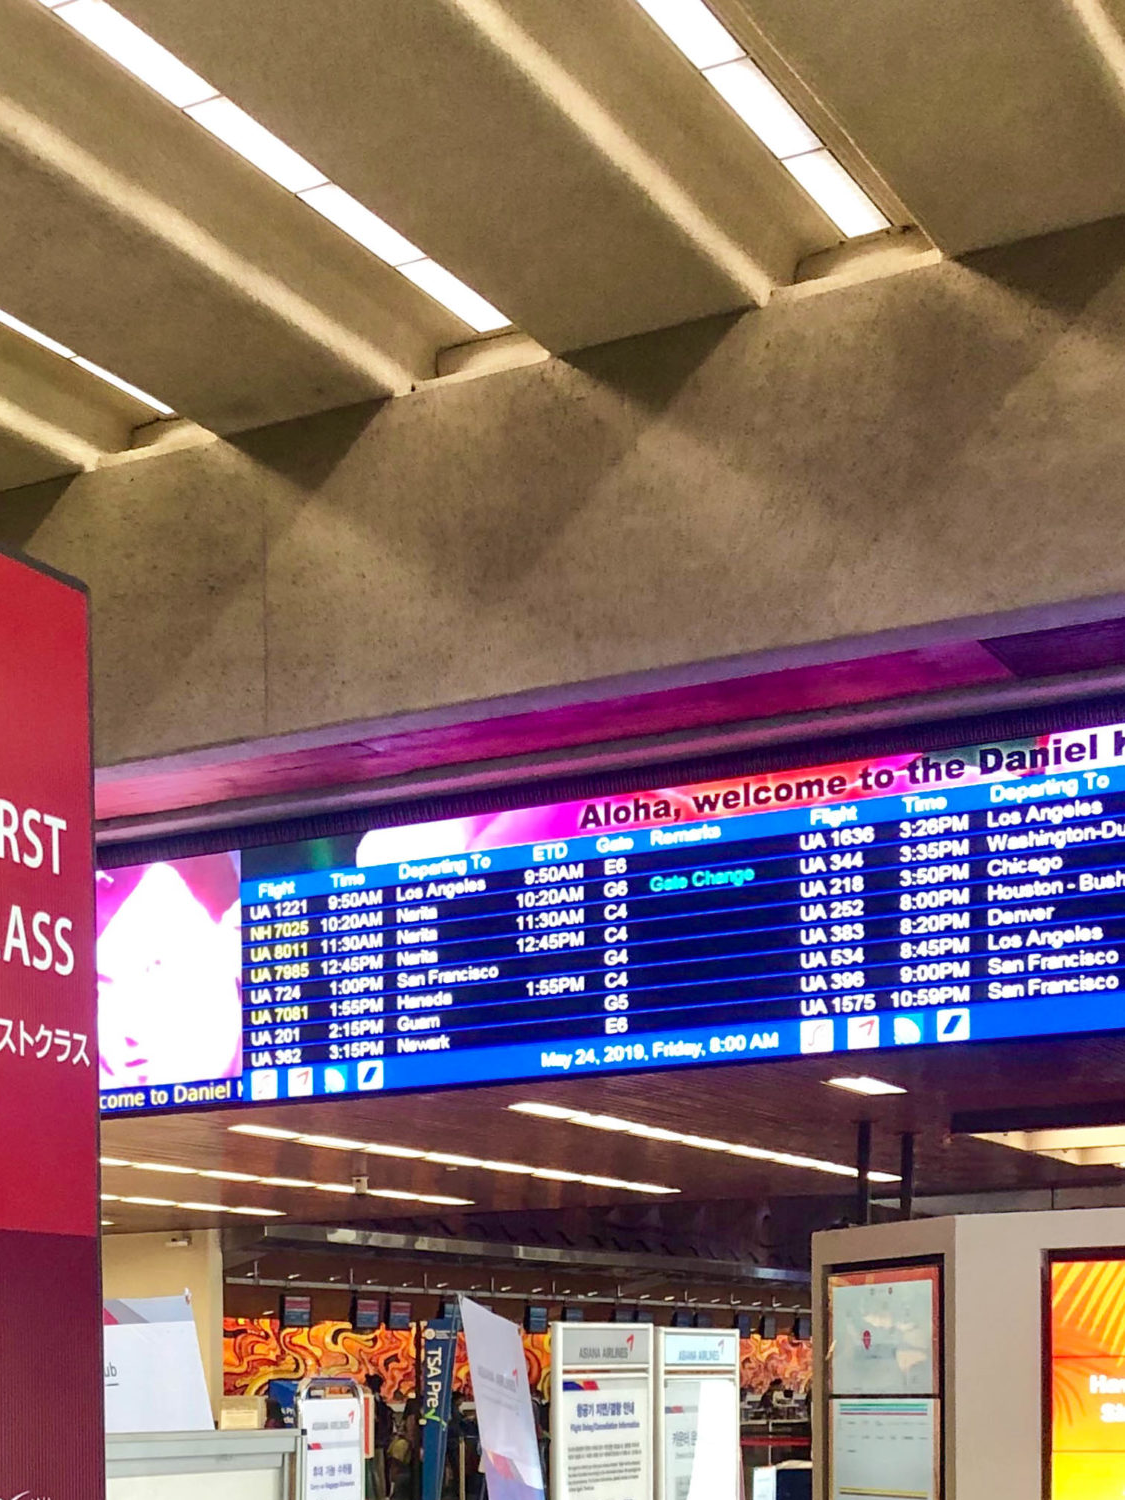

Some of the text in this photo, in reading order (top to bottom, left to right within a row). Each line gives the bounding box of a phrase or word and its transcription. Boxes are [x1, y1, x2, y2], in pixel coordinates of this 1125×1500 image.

[580, 798, 681, 830] Aloha,
[692, 774, 847, 813] welcome
[859, 766, 894, 791] to
[906, 756, 965, 785] the
[979, 734, 1098, 775] Daniel
[990, 771, 1110, 803] Departing To
[799, 832, 827, 851] UA
[899, 814, 969, 839] 3:26PM
[986, 810, 1022, 828] Los
[1025, 799, 1103, 825] Angeles
[810, 805, 858, 828] Flight
[901, 794, 948, 814] Time
[532, 842, 568, 862] ETD
[596, 836, 634, 854] Gate
[650, 823, 722, 847] Remarks
[799, 856, 827, 875] UA
[829, 851, 864, 872] 344
[899, 838, 970, 863] 3:35PM
[250, 857, 627, 920] UA 1221 9:50AM Los Angeles 9:50AM E6
[329, 873, 366, 888] Time
[398, 853, 492, 881] Departing To
[800, 856, 1063, 898] UA 218 3:50PM Chicago
[250, 866, 755, 941] NH 7025 10:20AM Narita 10:20AM G6 Gate Change
[258, 881, 295, 900] Flight
[800, 870, 1125, 922] UA 252 8:00PM Houston Bush
[250, 903, 628, 962] UA 8011 11:30AM Narita 11:30AM C4
[800, 927, 828, 946] UA
[899, 912, 970, 935] 8:20PM
[987, 906, 1056, 926] Denver
[800, 924, 1104, 969] UA 534 8:45PM Los Angeles
[251, 967, 272, 983] UA
[321, 954, 384, 975] 12:45PM
[397, 949, 438, 967] Narita
[516, 931, 585, 953] 12:45PM
[604, 926, 628, 943] C4
[800, 974, 828, 993] UA
[899, 961, 970, 984] 9:00PM
[987, 957, 1024, 975] San
[1027, 949, 1119, 972] Francisco
[251, 949, 629, 1004] UA 724 1:00PM San Francisco G4
[251, 971, 629, 1025] UA 7081 1:55PM Haneda 1:55PM C4
[800, 974, 1119, 1017] UA 1575 10:59PM San Francisco
[251, 993, 629, 1046] UA 201 2:15PM Guam G5
[251, 1051, 273, 1067] UA
[329, 1040, 384, 1060] 3:15PM
[397, 1034, 451, 1054] Newark
[605, 1016, 628, 1035] E6
[541, 1032, 779, 1070] May 24, 2019, Friday, 8:00 AM
[150, 1088, 169, 1105] to
[174, 1080, 231, 1103] Daniel
[427, 1347, 442, 1408] TSA Pre
